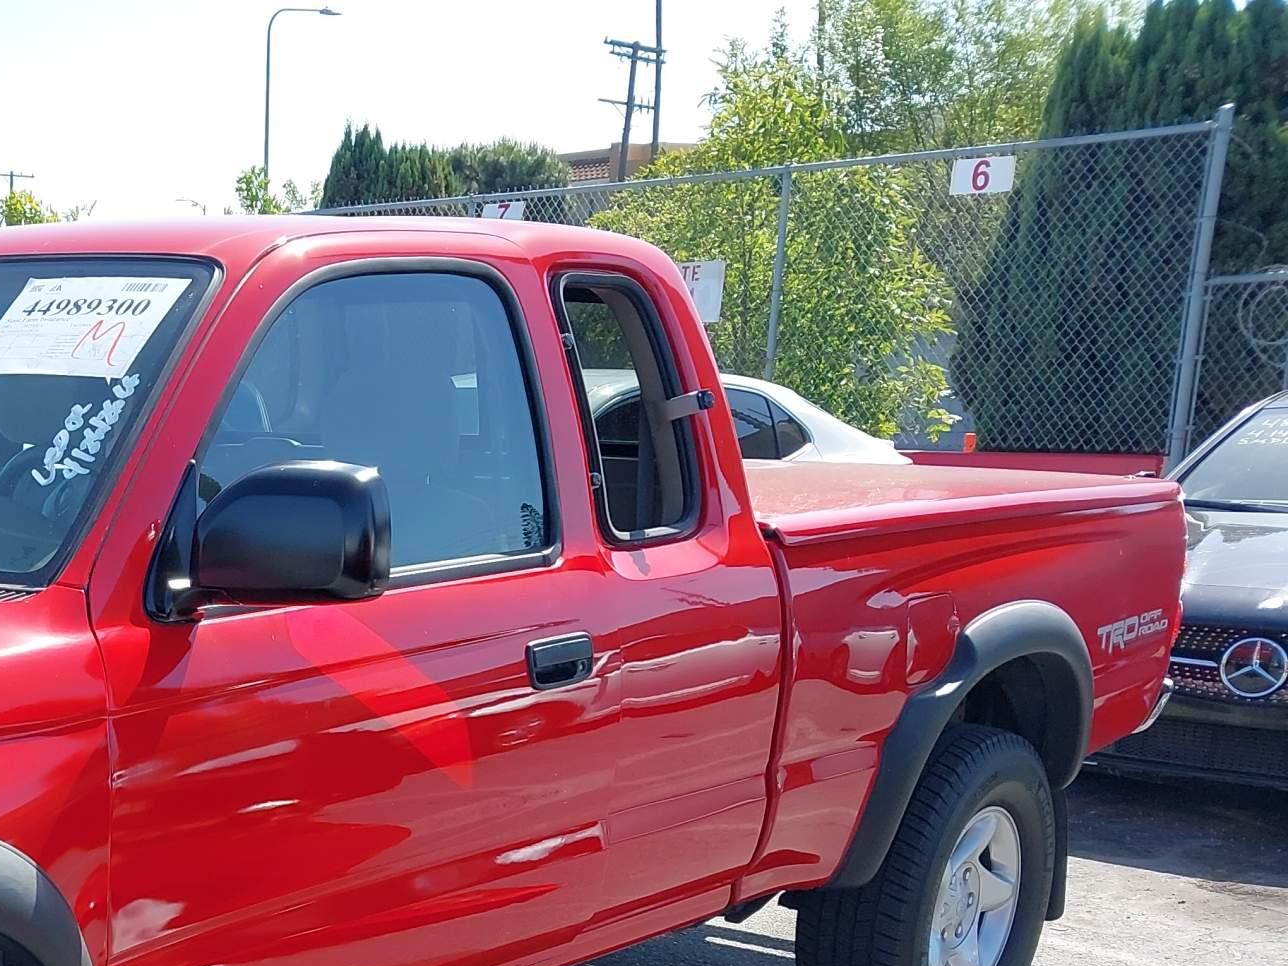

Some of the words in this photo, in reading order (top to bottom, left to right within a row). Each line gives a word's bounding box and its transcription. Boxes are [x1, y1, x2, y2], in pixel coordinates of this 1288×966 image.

[972, 159, 991, 191] 6
[497, 203, 511, 219] 7
[22, 298, 151, 316] 44989300
[70, 319, 126, 367] M
[1140, 608, 1163, 623] OFF
[1097, 615, 1139, 655] TRD
[1138, 619, 1169, 637] ROAD
